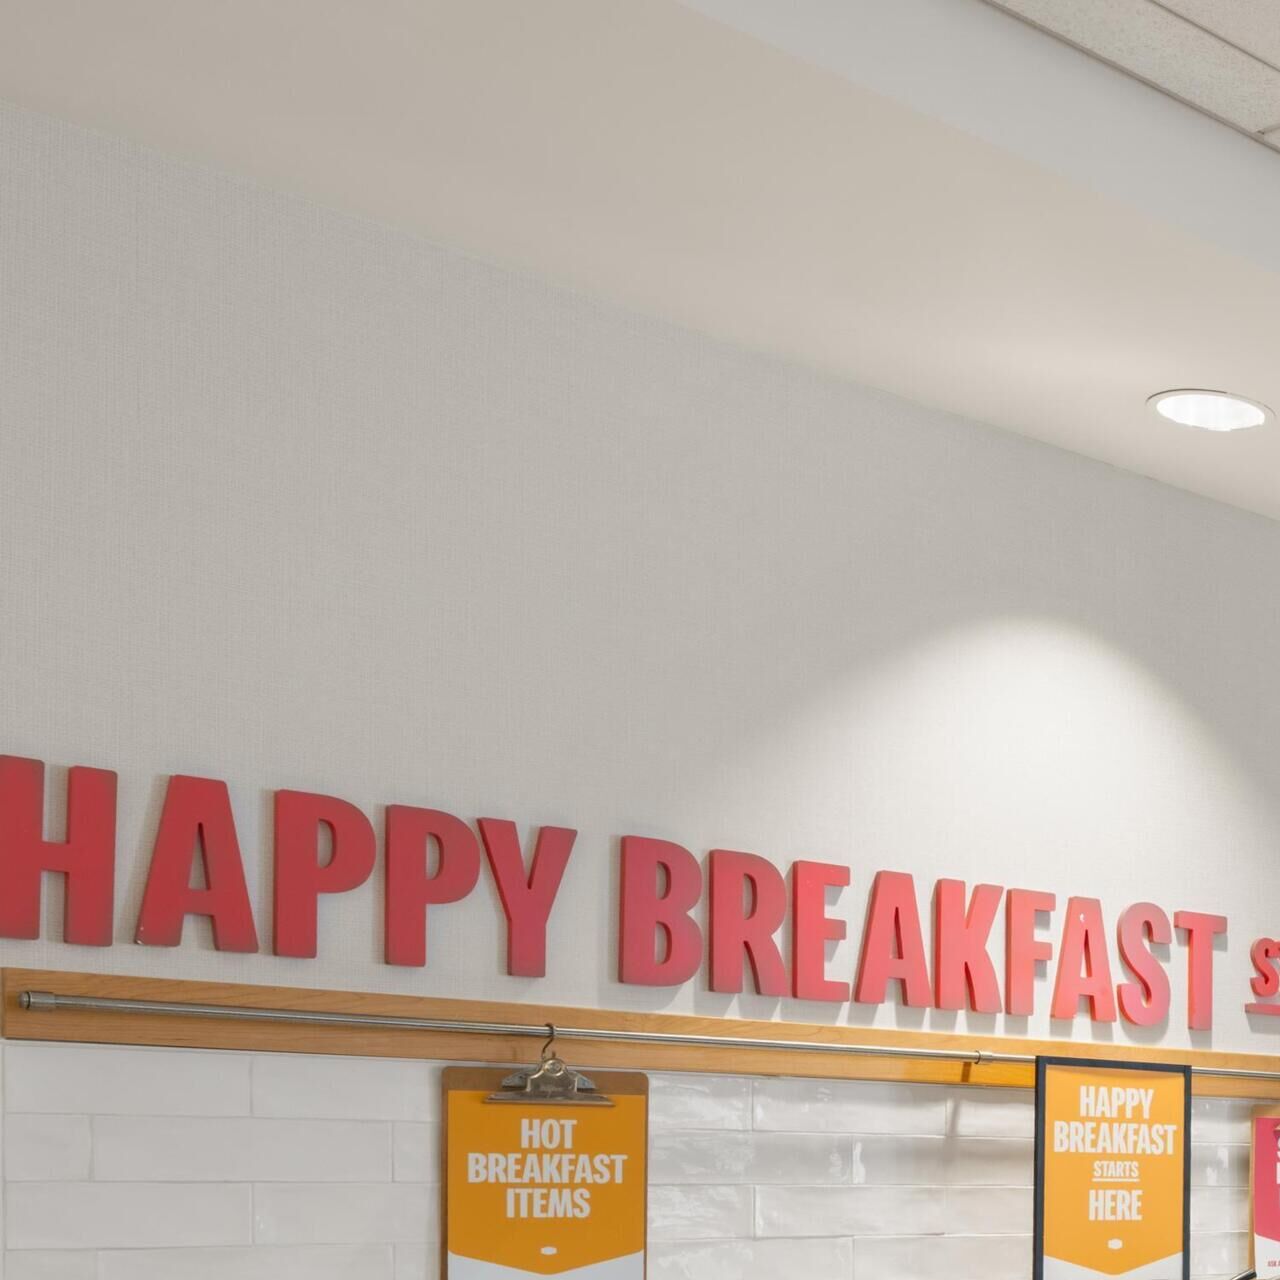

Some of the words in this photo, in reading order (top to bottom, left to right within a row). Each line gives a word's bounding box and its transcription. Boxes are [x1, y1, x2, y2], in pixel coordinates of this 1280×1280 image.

[0, 754, 578, 978] HAPPY
[618, 834, 1229, 1030] BREAKFAST
[1079, 1085, 1154, 1119] HAPPY
[520, 1118, 577, 1149] HOT
[1053, 1120, 1177, 1155] BREAKFAST
[467, 1152, 628, 1185] BREAKFAST
[1093, 1160, 1139, 1178] STARTS
[506, 1187, 591, 1219] ITEMS
[1088, 1189, 1143, 1221] HERE
